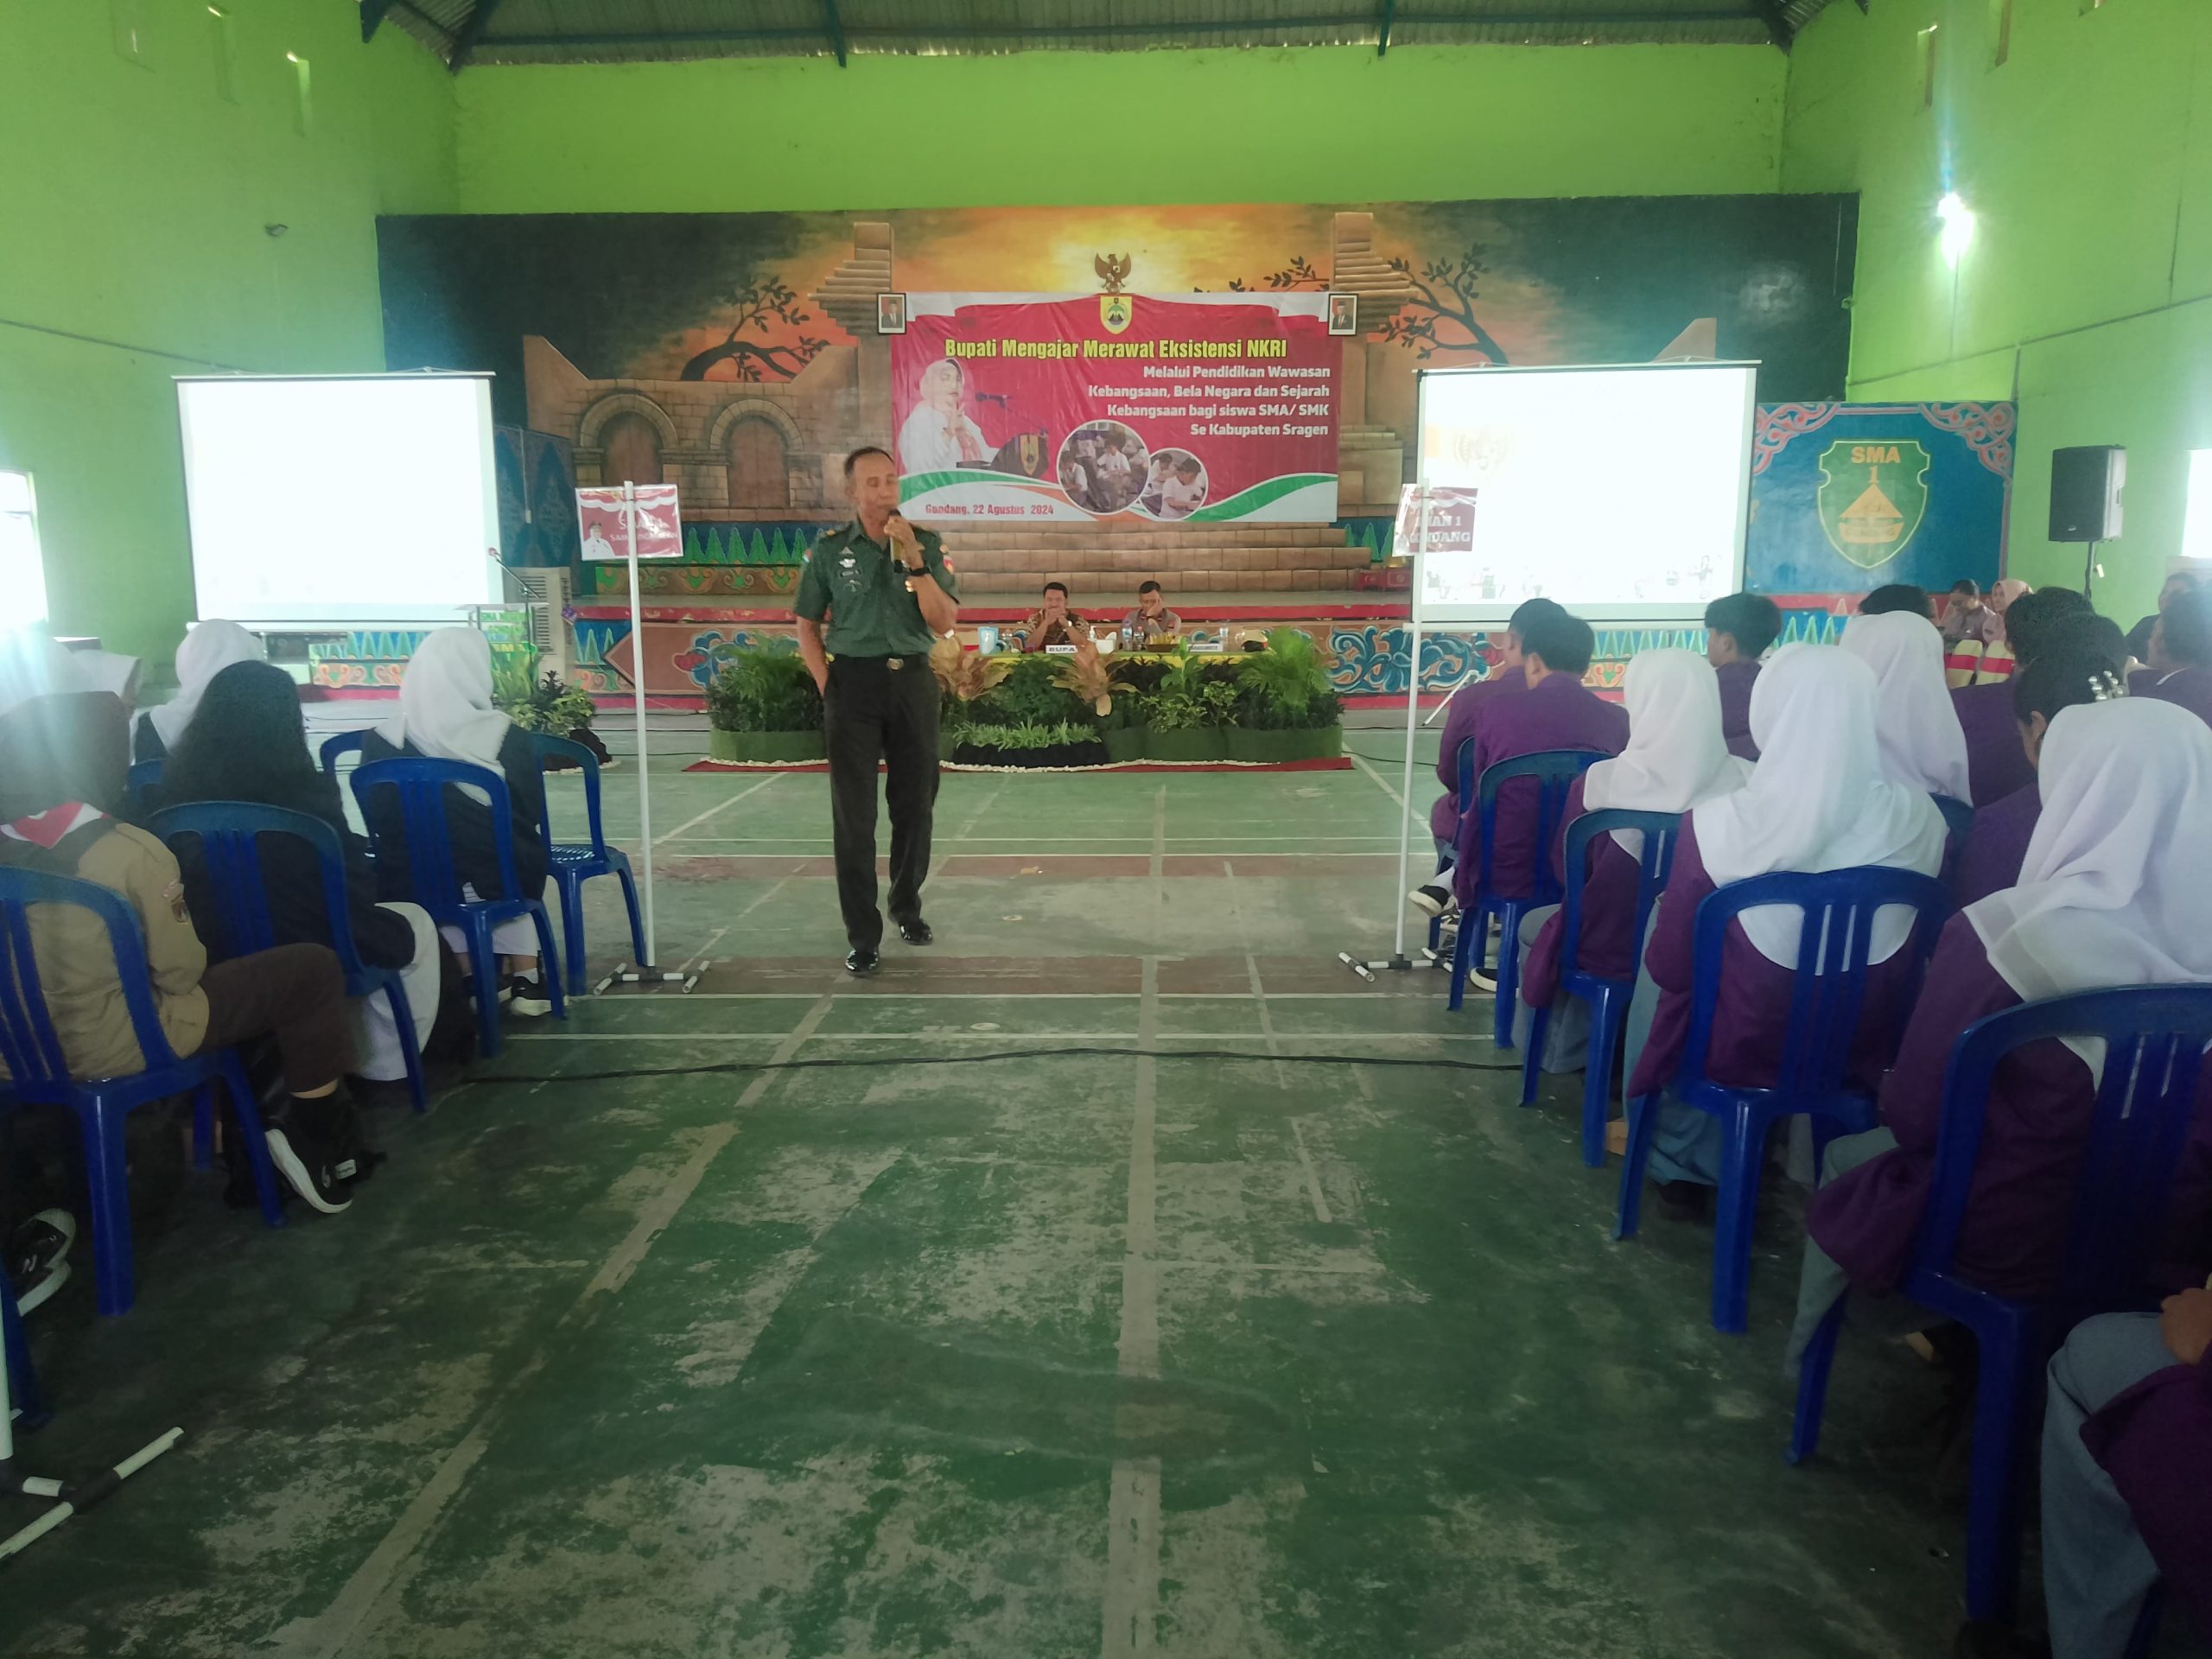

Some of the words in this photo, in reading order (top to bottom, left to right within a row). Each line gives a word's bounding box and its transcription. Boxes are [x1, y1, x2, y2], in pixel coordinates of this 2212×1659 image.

[945, 339, 997, 359] Bupati
[1001, 339, 1079, 359] Mengajar
[1084, 340, 1154, 359] Merawat
[1159, 339, 1243, 358] Eksistensi
[1246, 339, 1287, 358] NKRI
[1143, 365, 1190, 378] Melalui
[1192, 365, 1265, 378] Pendidikan
[1268, 365, 1331, 378] Wawasan
[1088, 385, 1171, 400] Kebangsaan,
[1173, 385, 1202, 397] Bela
[1205, 385, 1252, 399] Negara
[1254, 385, 1278, 397] dan
[1281, 385, 1330, 399] Sejarah
[1107, 404, 1186, 419] Kebangsaan
[1189, 404, 1217, 419] bagi
[1219, 404, 1256, 416] siswa
[1258, 404, 1297, 416] SMA/
[1299, 404, 1329, 416] SMK
[1191, 423, 1206, 435] Se
[1209, 423, 1280, 438] Kabupaten
[1282, 423, 1329, 438] Sragen
[1851, 446, 1900, 463] SMA
[972, 504, 984, 515] 22
[988, 505, 1025, 516] Agustus
[1031, 505, 1054, 515] 2024
[1455, 516, 1462, 527] 1
